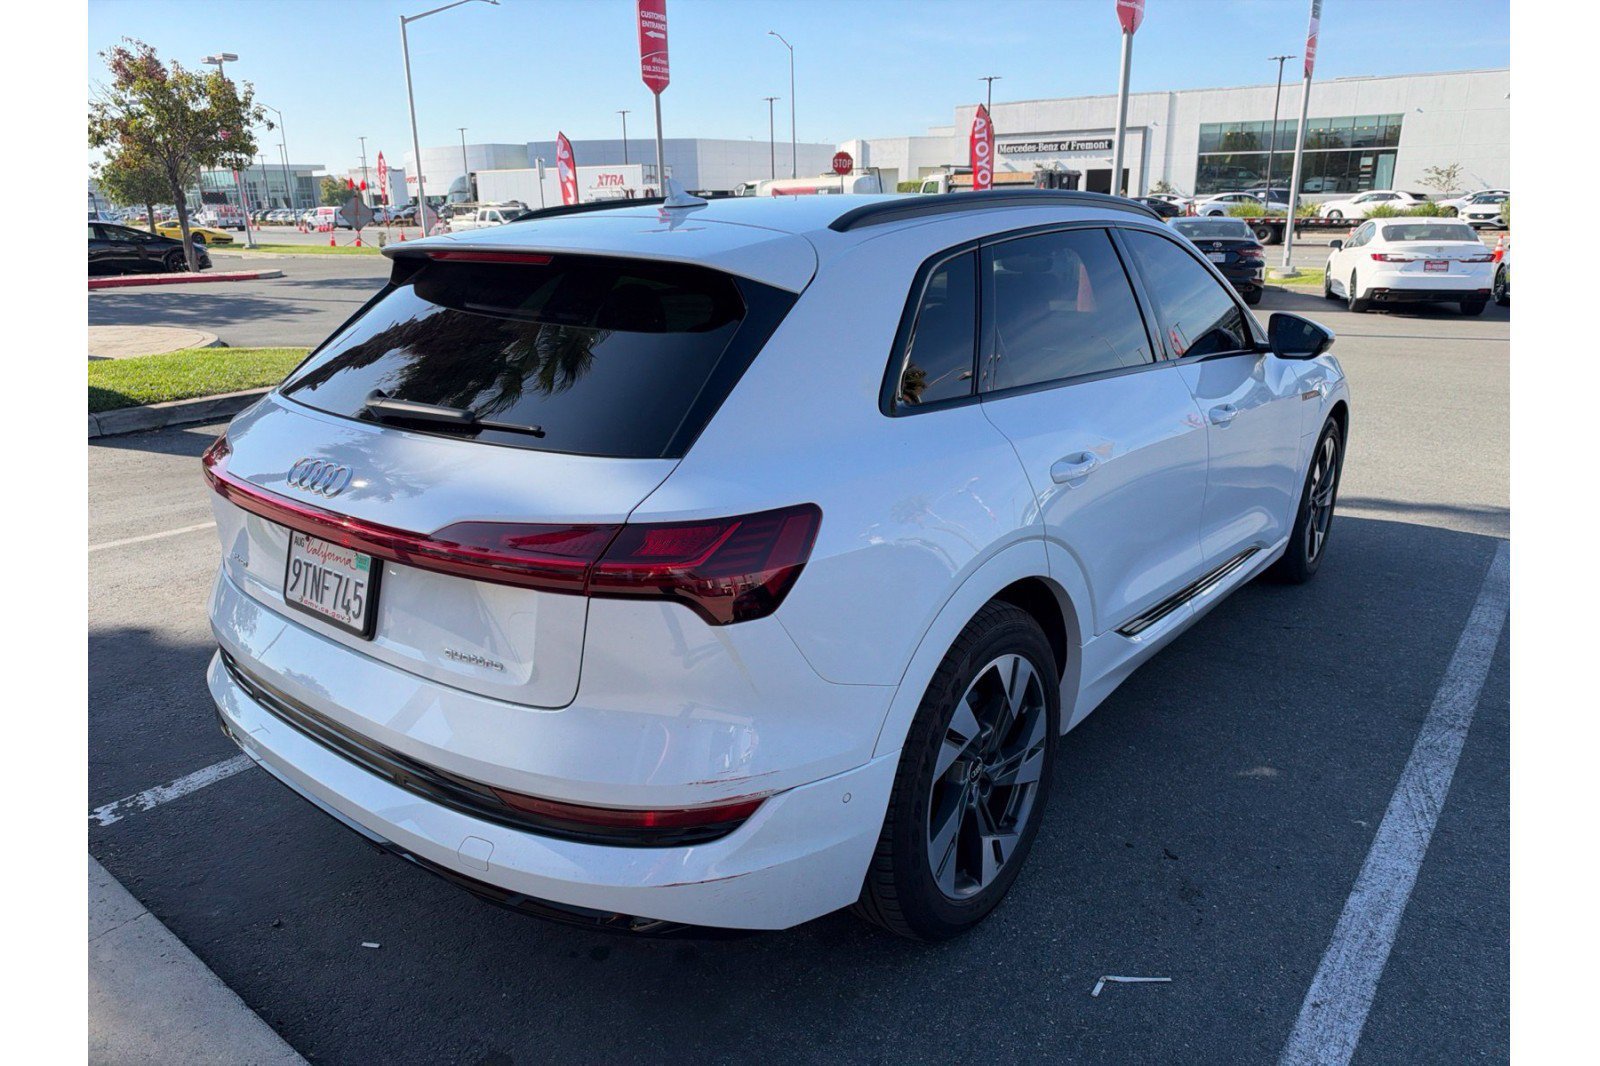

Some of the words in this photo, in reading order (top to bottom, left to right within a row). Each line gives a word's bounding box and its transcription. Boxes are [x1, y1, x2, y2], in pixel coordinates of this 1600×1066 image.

[1000, 142, 1058, 153] Mercedes-Benz
[1060, 141, 1068, 150] of
[1071, 140, 1108, 150] Fremont
[834, 159, 852, 168] STOP
[597, 174, 625, 187] XTRA
[294, 535, 305, 548] AUG
[306, 540, 356, 570] California
[289, 558, 364, 619] 9TNF745
